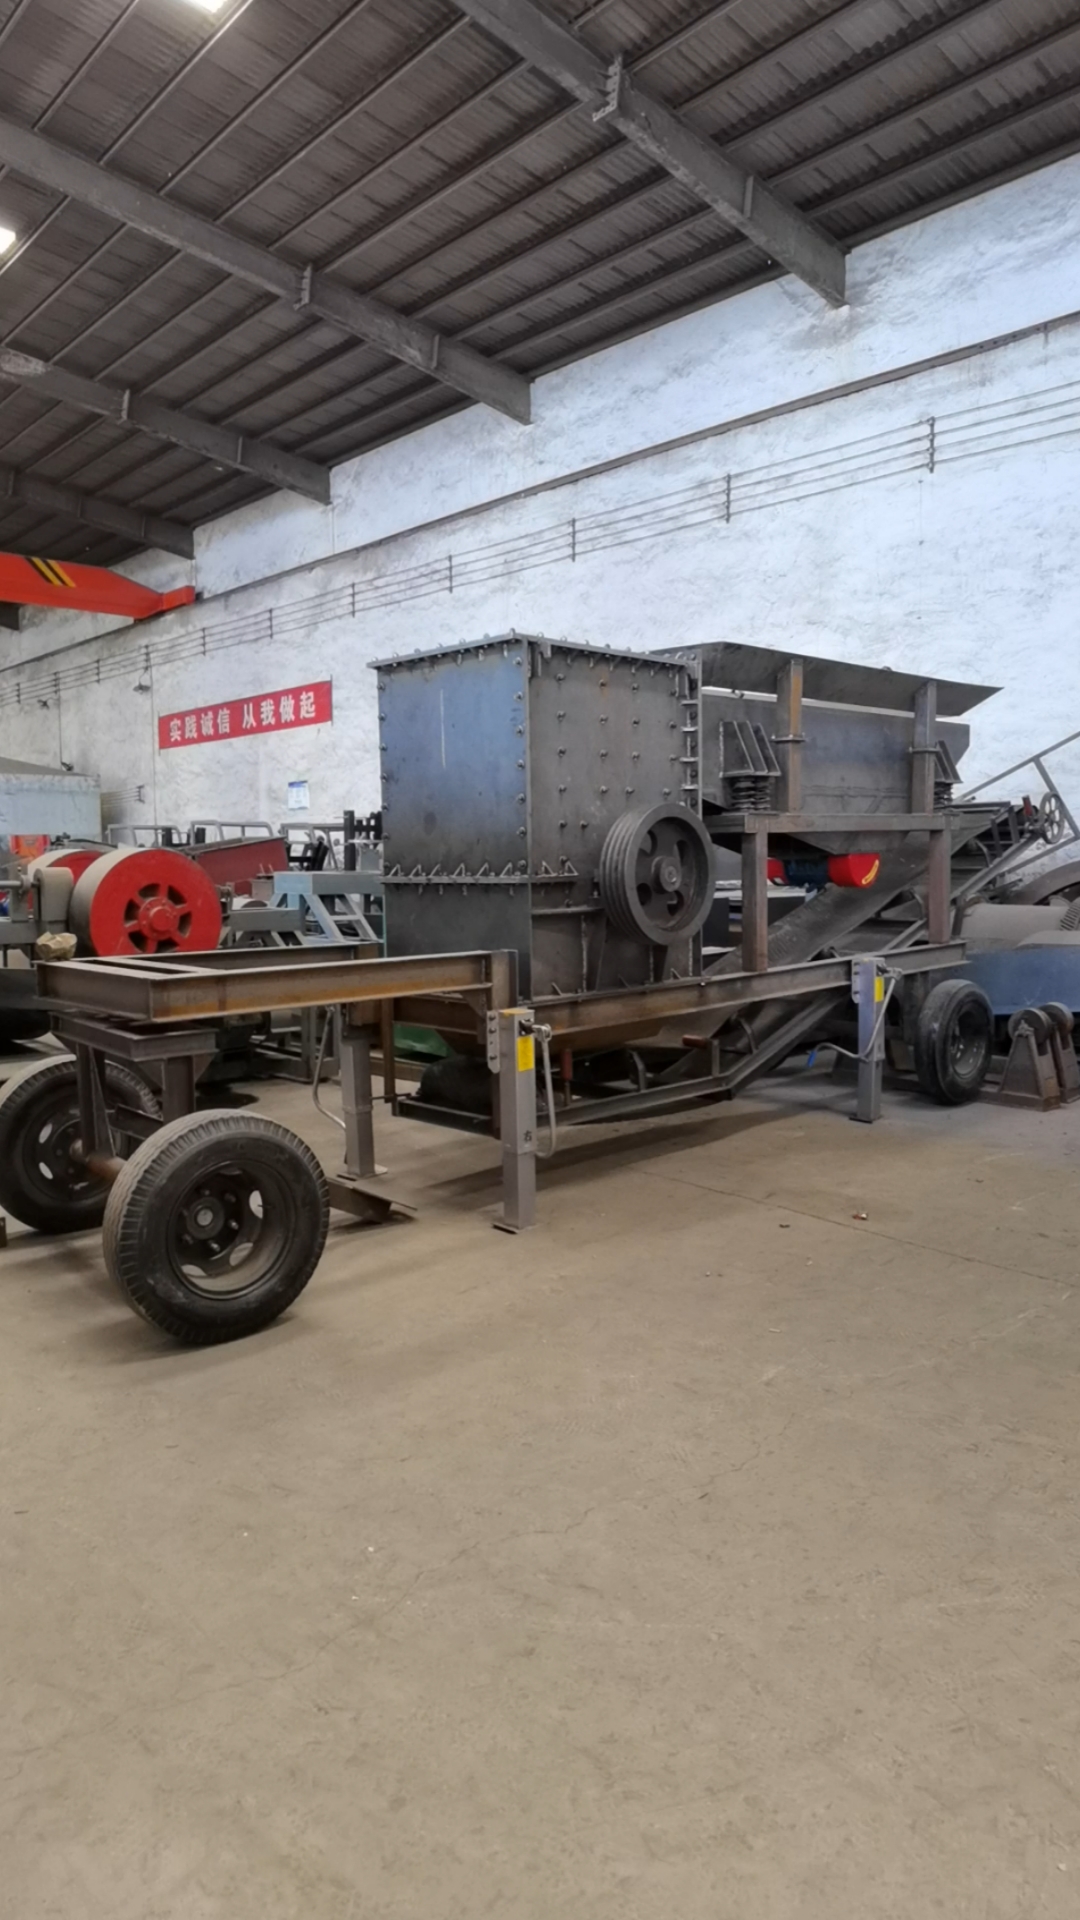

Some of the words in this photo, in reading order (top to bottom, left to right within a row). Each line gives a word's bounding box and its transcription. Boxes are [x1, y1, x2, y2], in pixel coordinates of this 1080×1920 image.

[169, 708, 231, 742] 实践诚信
[242, 691, 316, 729] 从我做起
